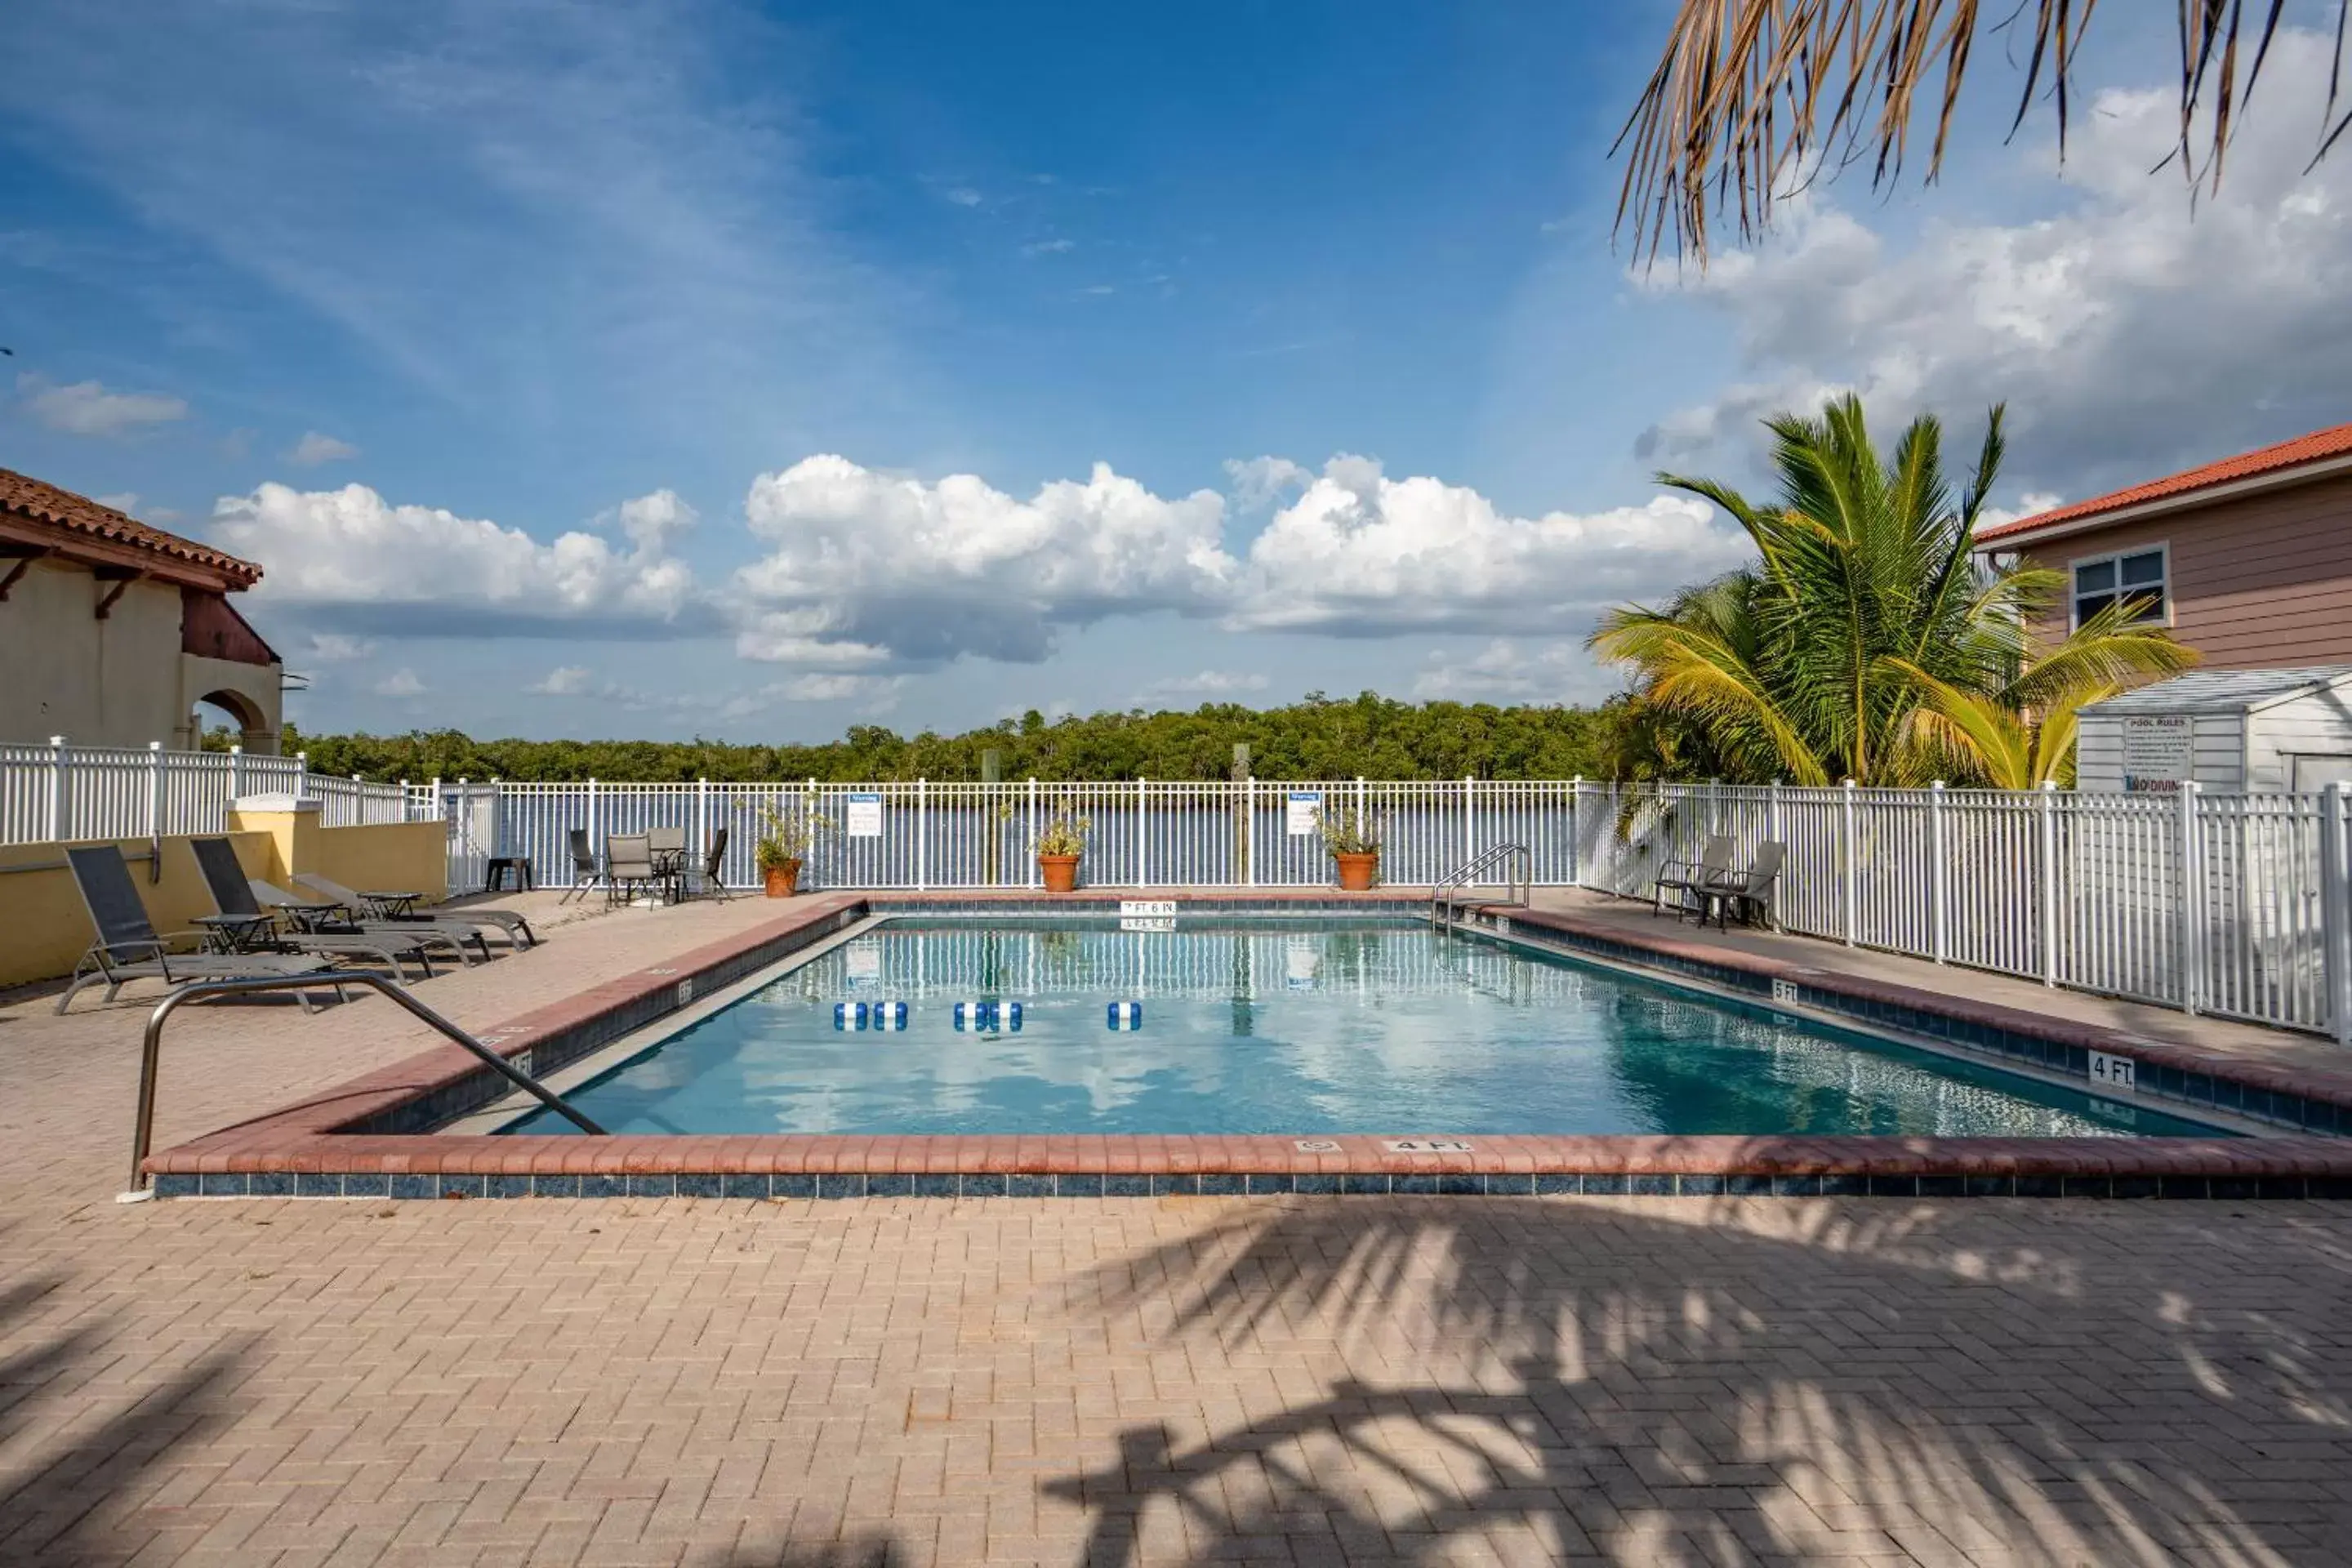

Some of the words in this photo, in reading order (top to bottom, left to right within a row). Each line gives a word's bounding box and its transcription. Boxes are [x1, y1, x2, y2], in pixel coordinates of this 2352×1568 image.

[2130, 719, 2154, 727] POOL
[2157, 719, 2185, 727] RULES
[2132, 777, 2147, 791] NO
[2150, 779, 2180, 792] DIVIN
[1775, 982, 1782, 998] 5
[2095, 1057, 2105, 1078] 4
[1397, 1142, 1419, 1151] 4
